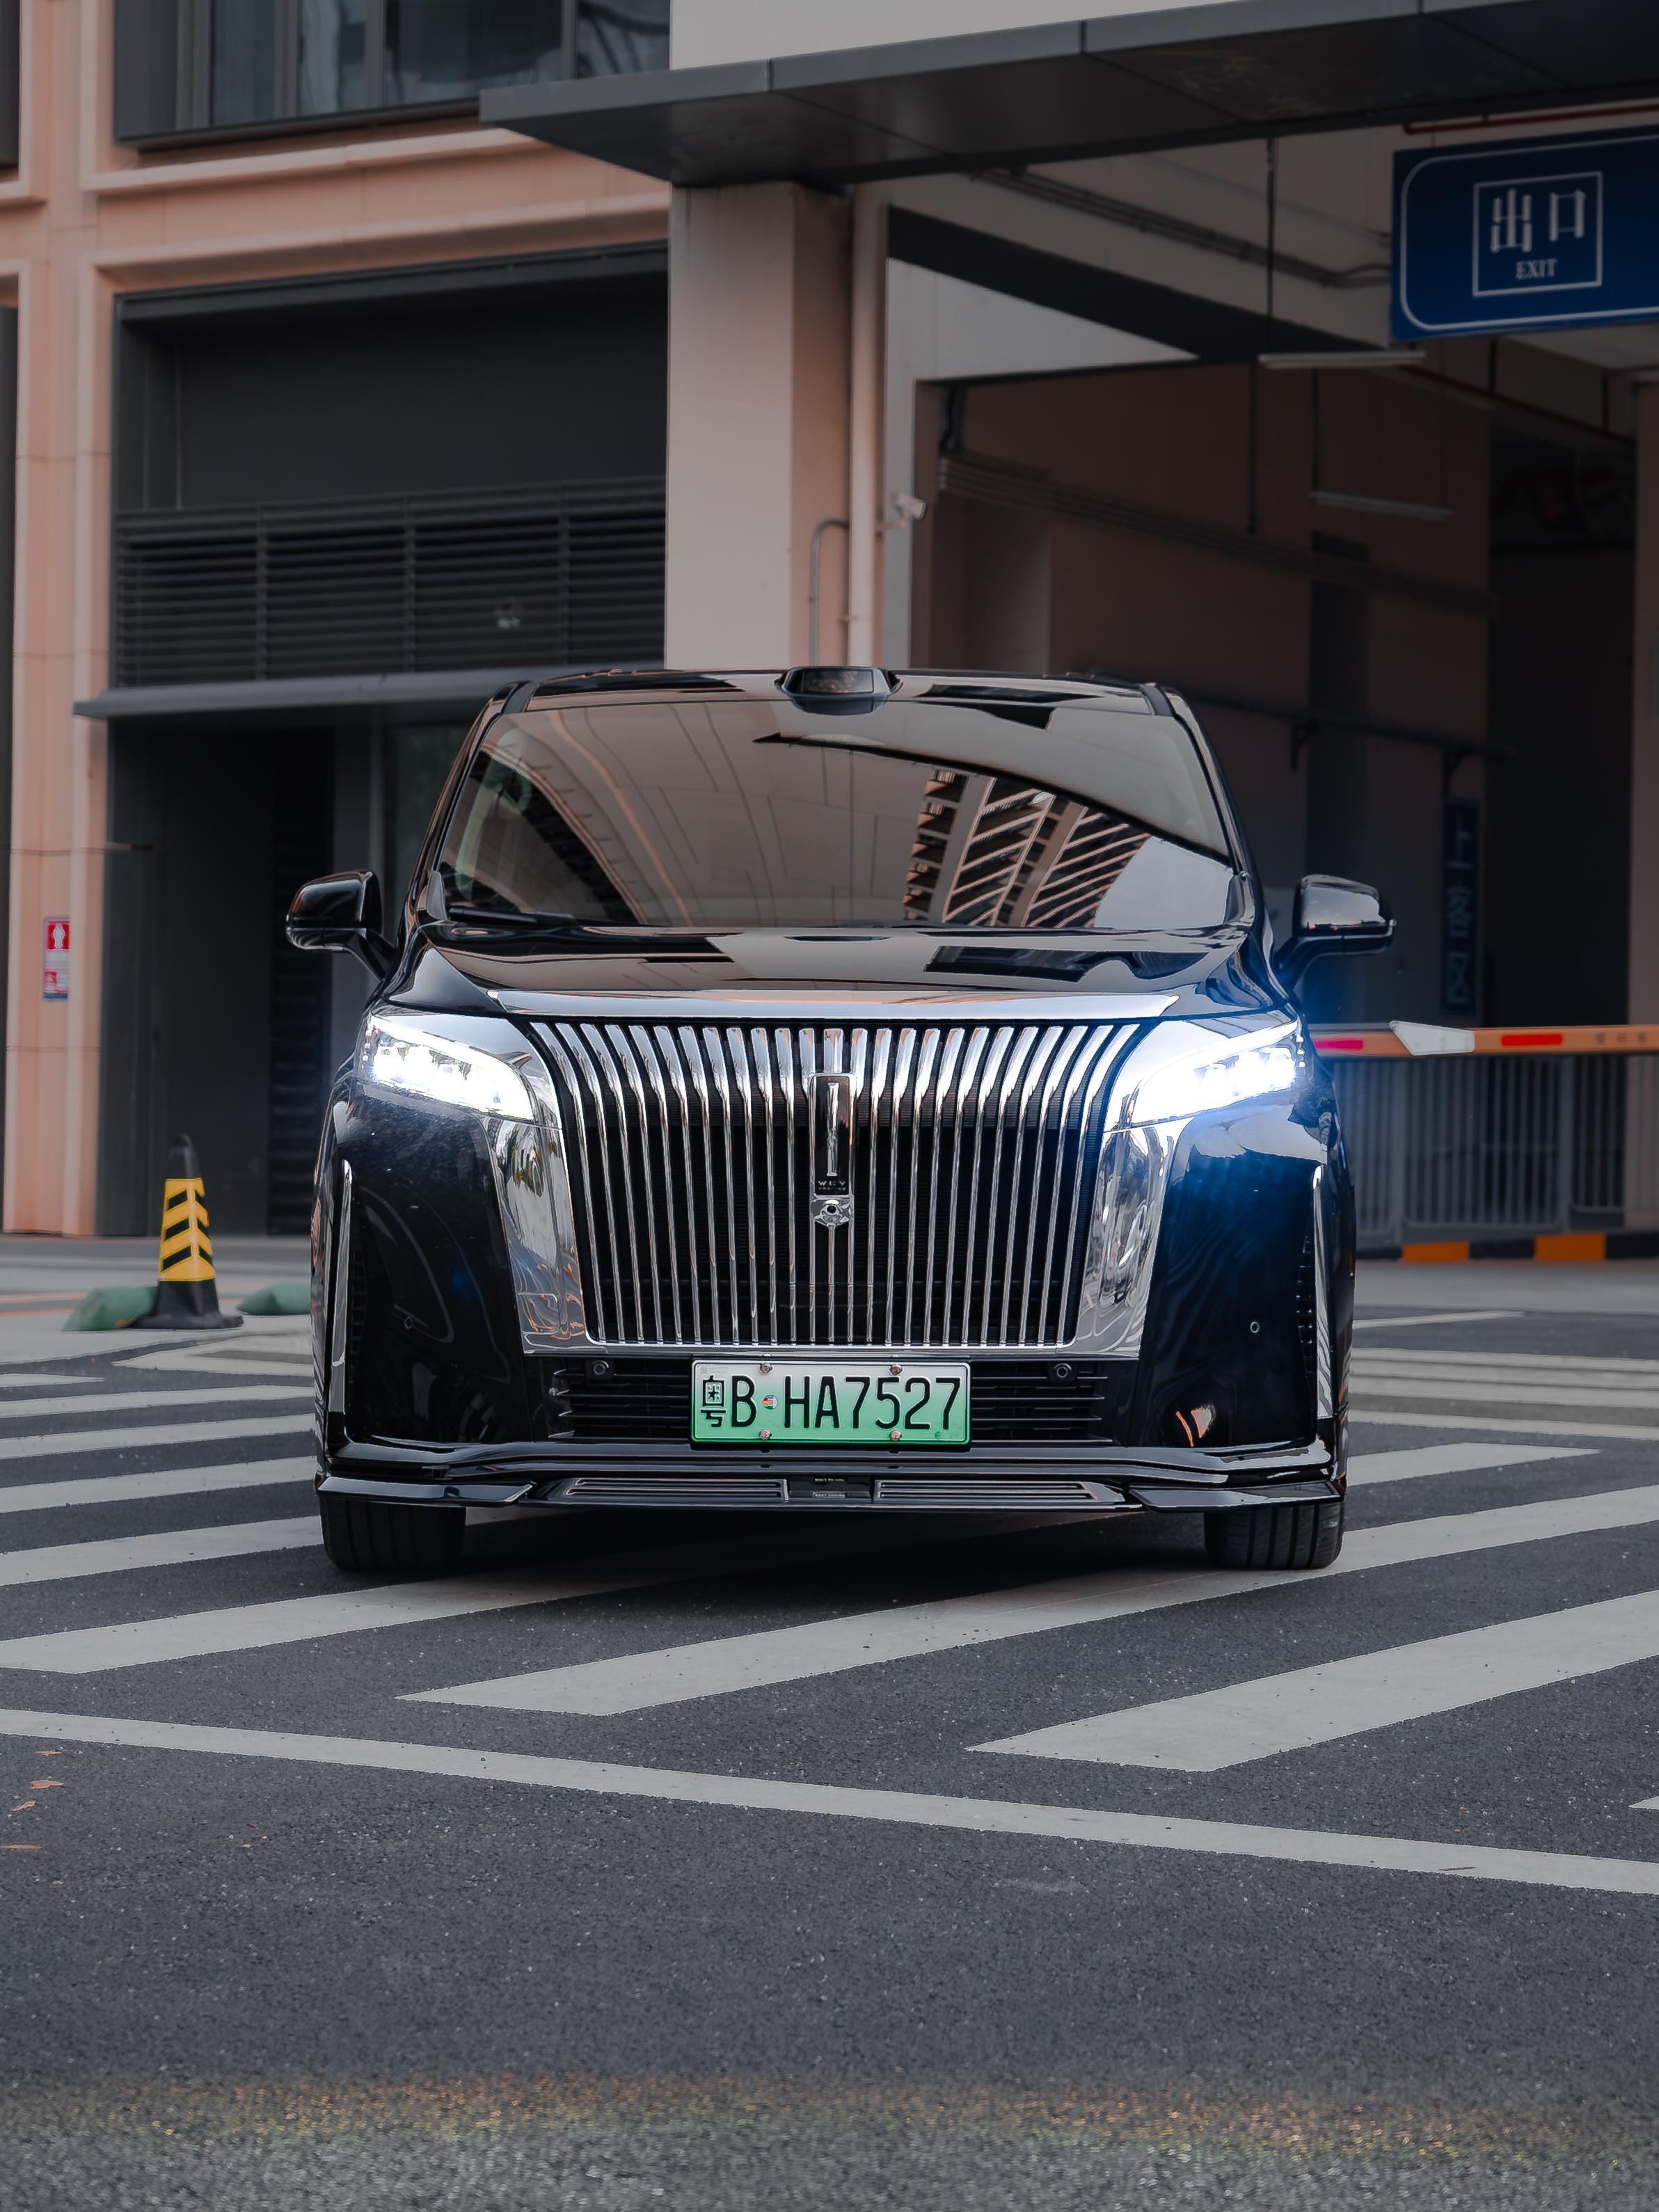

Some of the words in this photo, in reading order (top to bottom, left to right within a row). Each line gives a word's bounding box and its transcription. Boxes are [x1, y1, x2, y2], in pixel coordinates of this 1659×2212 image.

[1490, 188, 1586, 253] 出口
[1515, 258, 1558, 280] EXIT
[784, 1375, 961, 1430] HA7527
